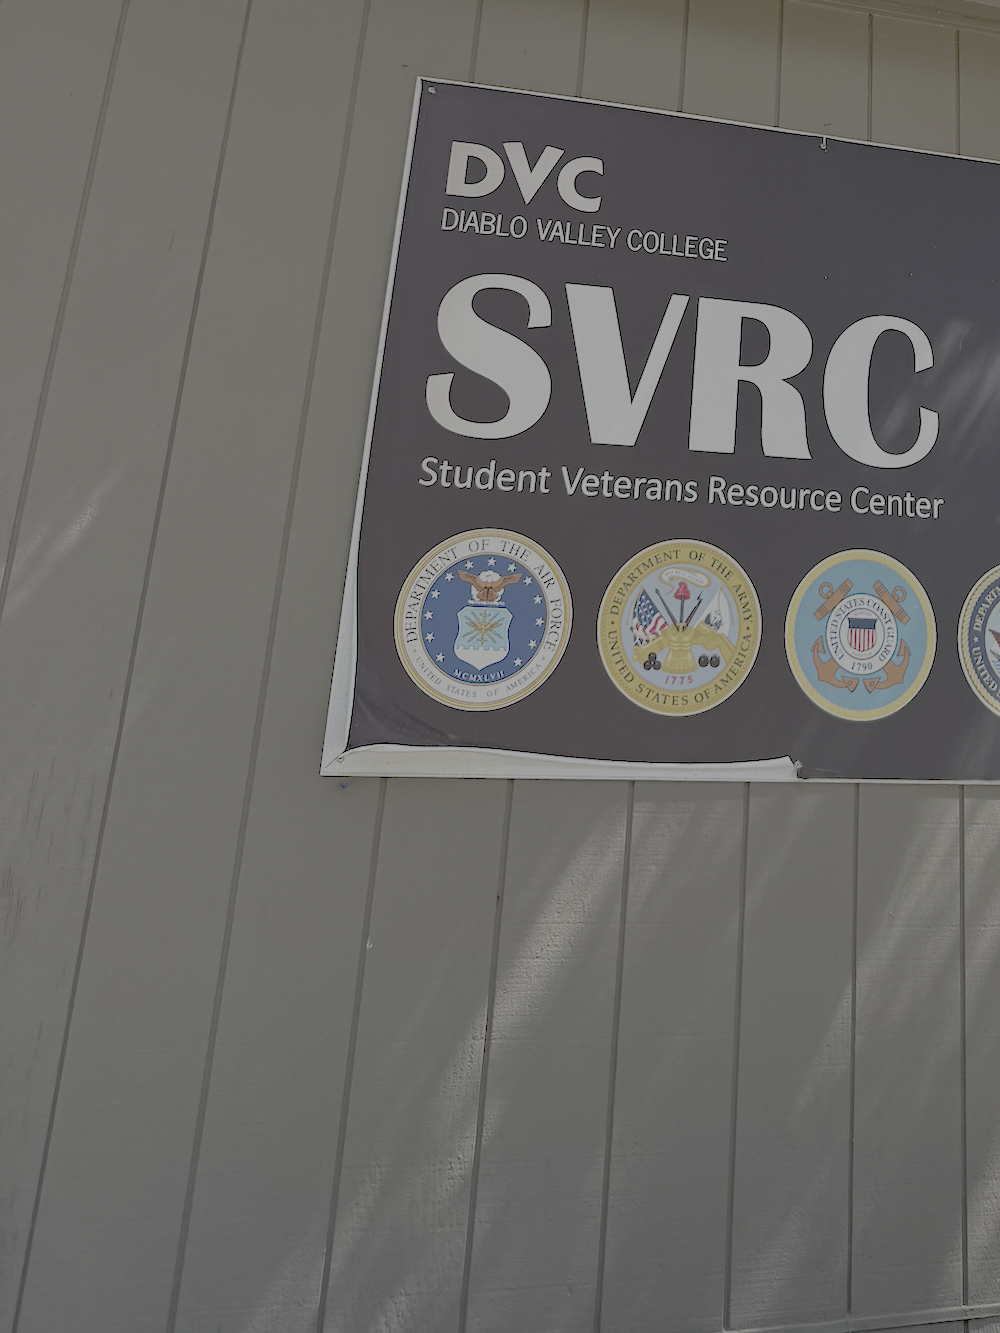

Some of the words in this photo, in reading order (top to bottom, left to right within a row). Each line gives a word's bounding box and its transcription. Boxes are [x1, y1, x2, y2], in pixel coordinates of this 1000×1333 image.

[445, 141, 603, 213] DVC
[441, 207, 528, 239] DIABLO
[536, 218, 622, 249] VALLEY
[626, 229, 728, 262] COLLEGE
[425, 273, 941, 469] SVRC
[418, 456, 551, 495] Student
[561, 466, 699, 503] Veterans
[708, 476, 842, 513] Resource
[849, 485, 945, 519] Center
[468, 539, 490, 552] OF
[500, 539, 532, 563] THE
[405, 546, 458, 643] DEPARTMENT
[533, 564, 557, 589] AIR
[610, 549, 681, 616] DEPARTMENT
[688, 550, 706, 562] OF
[710, 557, 735, 581] THE
[732, 584, 754, 627] ARMY
[543, 598, 563, 652] FORCE
[835, 597, 865, 622] STATES
[866, 598, 893, 625] COAST
[829, 621, 845, 661] UNITED
[878, 626, 895, 662] GUARD
[415, 656, 442, 685] UNITED
[445, 684, 477, 698] STATES
[486, 688, 499, 698] OF
[505, 663, 543, 692] AMERICA
[608, 630, 635, 683] UNITED
[635, 683, 689, 706] STATES
[694, 687, 712, 704] OF
[713, 634, 752, 694] AMERICA
[665, 675, 694, 685] 1775
[851, 661, 873, 671] 1790
[972, 646, 998, 692] UNITED
